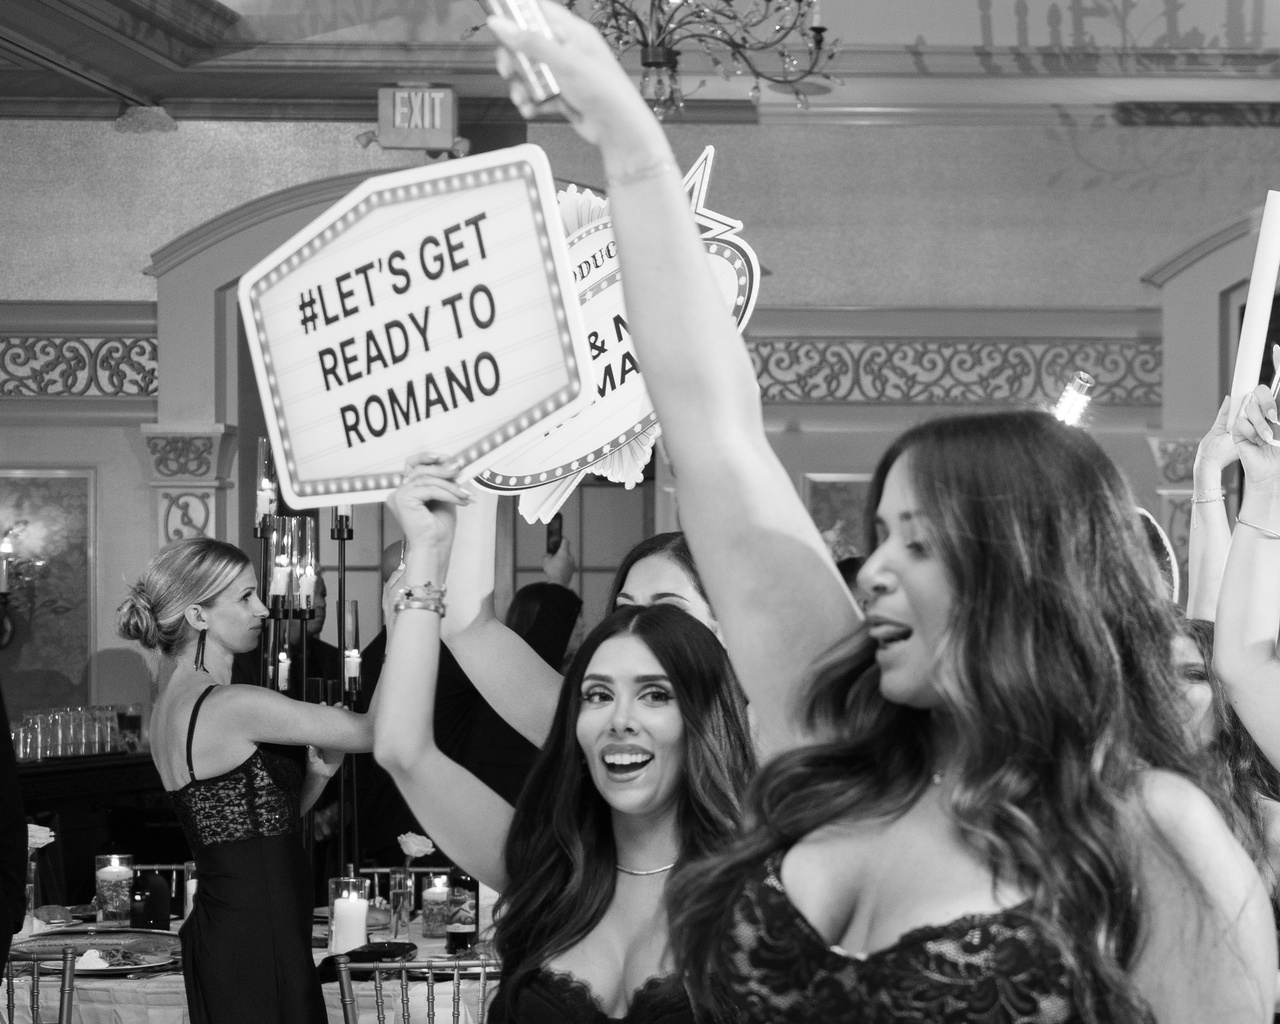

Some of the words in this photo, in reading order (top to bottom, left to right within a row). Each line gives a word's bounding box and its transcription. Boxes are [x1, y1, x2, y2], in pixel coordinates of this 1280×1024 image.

[394, 91, 445, 129] EXIT
[298, 250, 411, 335] #LET'S
[419, 212, 487, 281] GET
[318, 305, 430, 392] READY
[441, 284, 496, 339] TO
[339, 351, 501, 448] ROMANO
